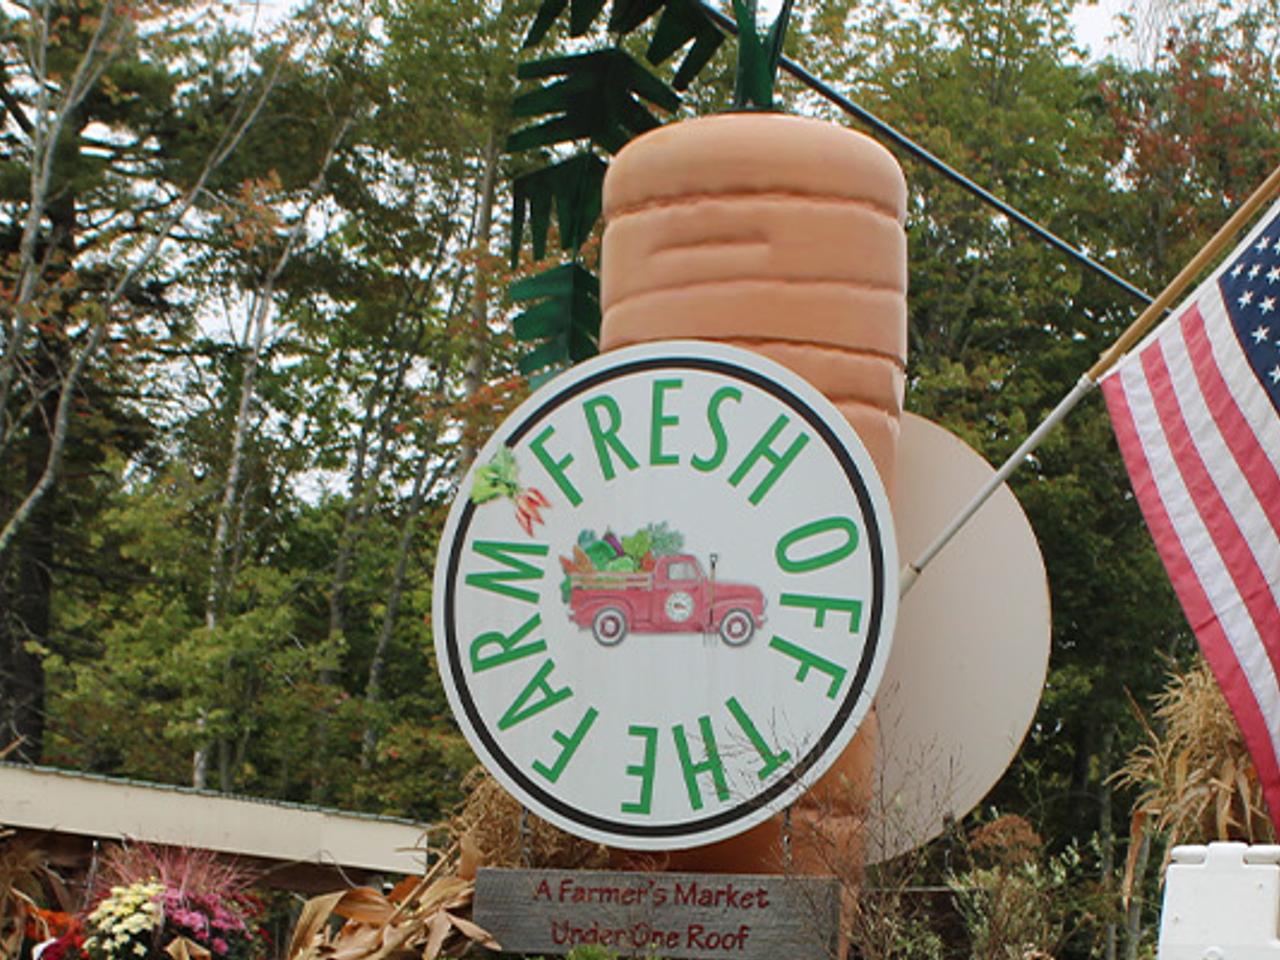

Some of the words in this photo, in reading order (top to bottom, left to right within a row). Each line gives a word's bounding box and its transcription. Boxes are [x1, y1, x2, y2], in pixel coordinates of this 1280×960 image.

[529, 378, 810, 507] FRESH
[465, 540, 599, 784] FARM
[768, 516, 862, 700] OFF
[621, 696, 791, 815] THE
[534, 879, 553, 900] A
[558, 878, 668, 906] Farmer's
[674, 881, 770, 910] Market
[552, 919, 624, 946] Under
[631, 922, 679, 948] One
[687, 924, 752, 951] Roof
